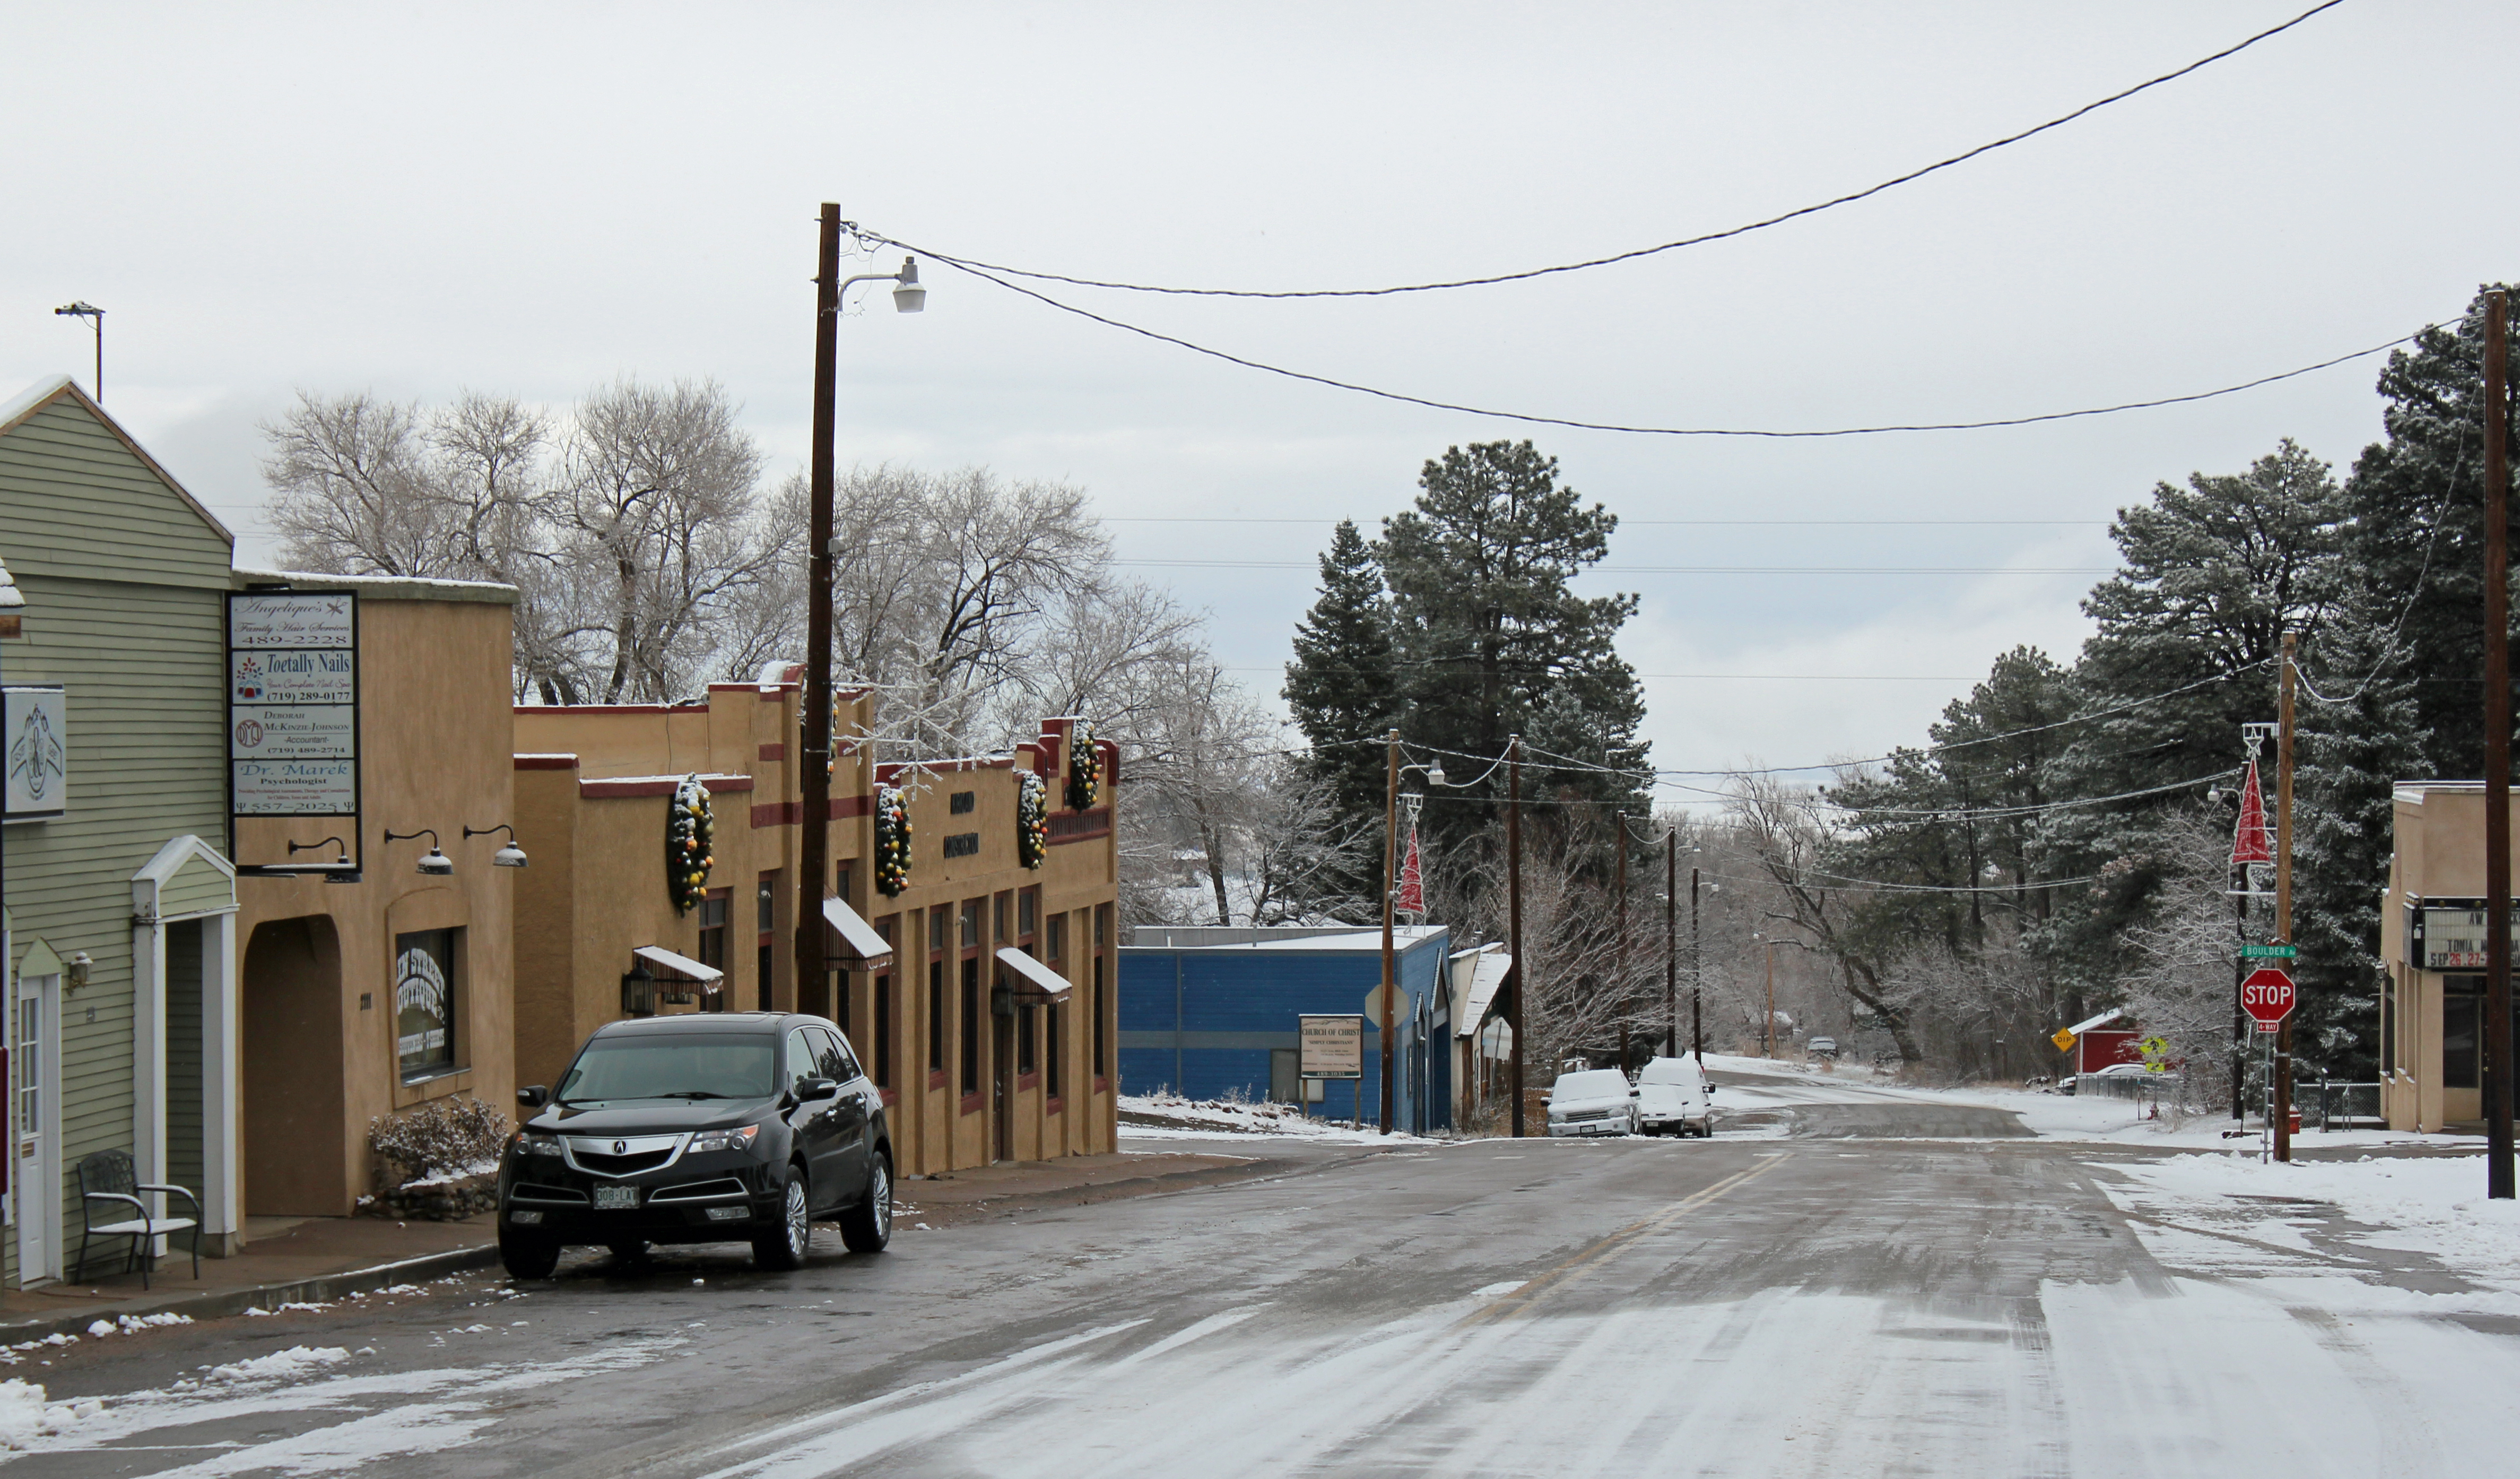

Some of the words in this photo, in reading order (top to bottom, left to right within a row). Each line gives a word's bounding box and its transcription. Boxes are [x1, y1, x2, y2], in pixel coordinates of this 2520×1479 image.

[234, 598, 323, 619] Angelique's
[234, 622, 273, 635] Family
[276, 621, 306, 632] Hair
[309, 621, 350, 633] Services
[242, 636, 347, 644] 489-2228
[267, 654, 314, 678] Toetally
[319, 653, 350, 672] Nails
[266, 678, 282, 688] Your
[284, 679, 315, 690] Complete
[317, 679, 333, 688] Nail
[335, 679, 351, 690] Spa
[267, 692, 296, 702] (719)
[300, 691, 350, 700] 289-0177
[240, 764, 274, 775] Dr.
[282, 760, 349, 775] Marek
[411, 948, 445, 1002] STREET
[397, 978, 438, 1018] OUTIQUE
[2245, 985, 2291, 1005] STOP
